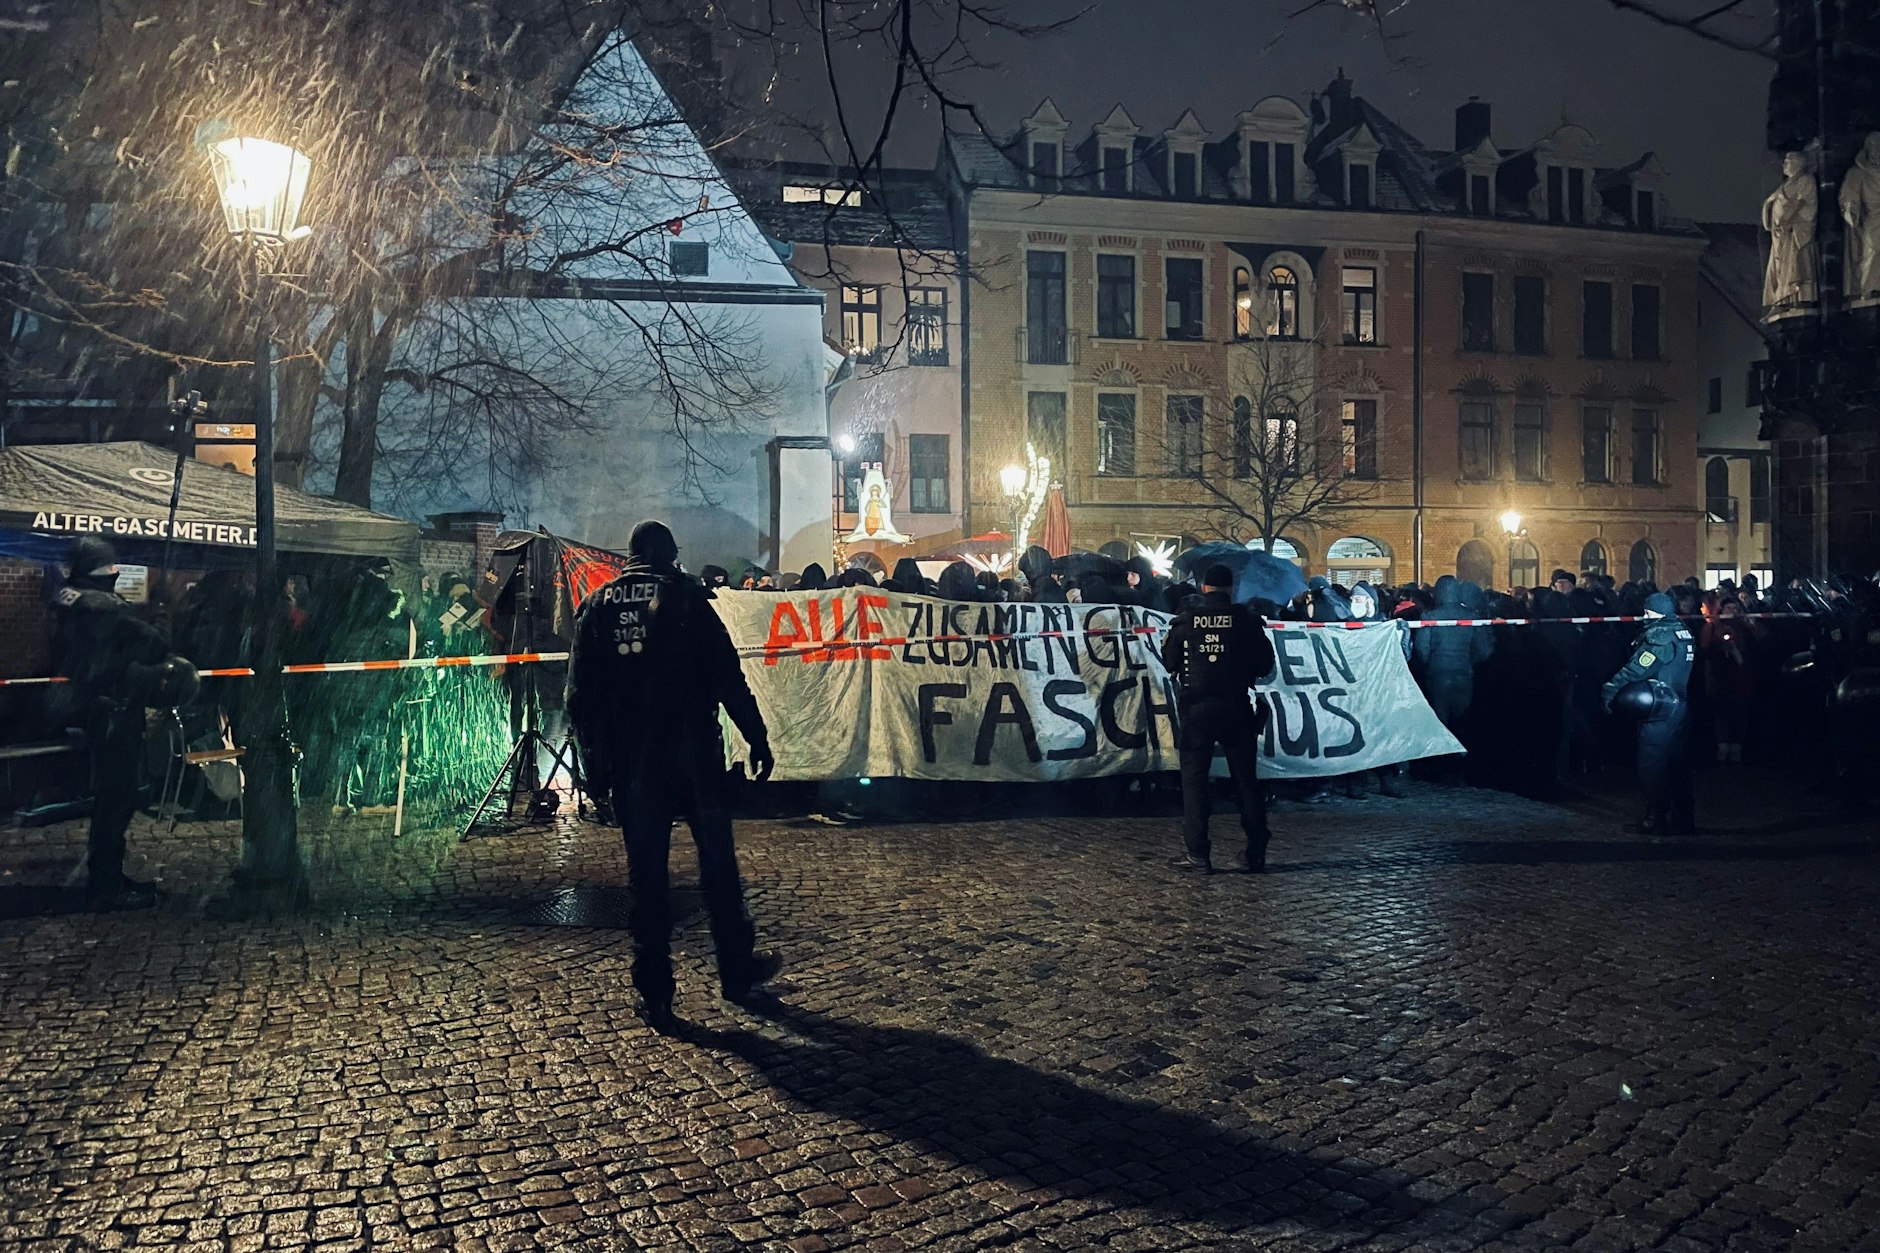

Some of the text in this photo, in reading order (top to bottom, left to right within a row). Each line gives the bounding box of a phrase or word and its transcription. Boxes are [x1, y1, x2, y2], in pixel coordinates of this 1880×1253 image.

[32, 511, 258, 545] ALTER-GASOMETER.D
[603, 583, 658, 605] POLIZEI
[619, 611, 639, 625] SN
[1193, 615, 1233, 629] POLIZEI
[613, 625, 647, 642] 31/21
[763, 594, 892, 667] ALLE
[1204, 634, 1220, 643] SN
[1199, 644, 1225, 653] 31/21
[918, 676, 1366, 765] FASCHUS
